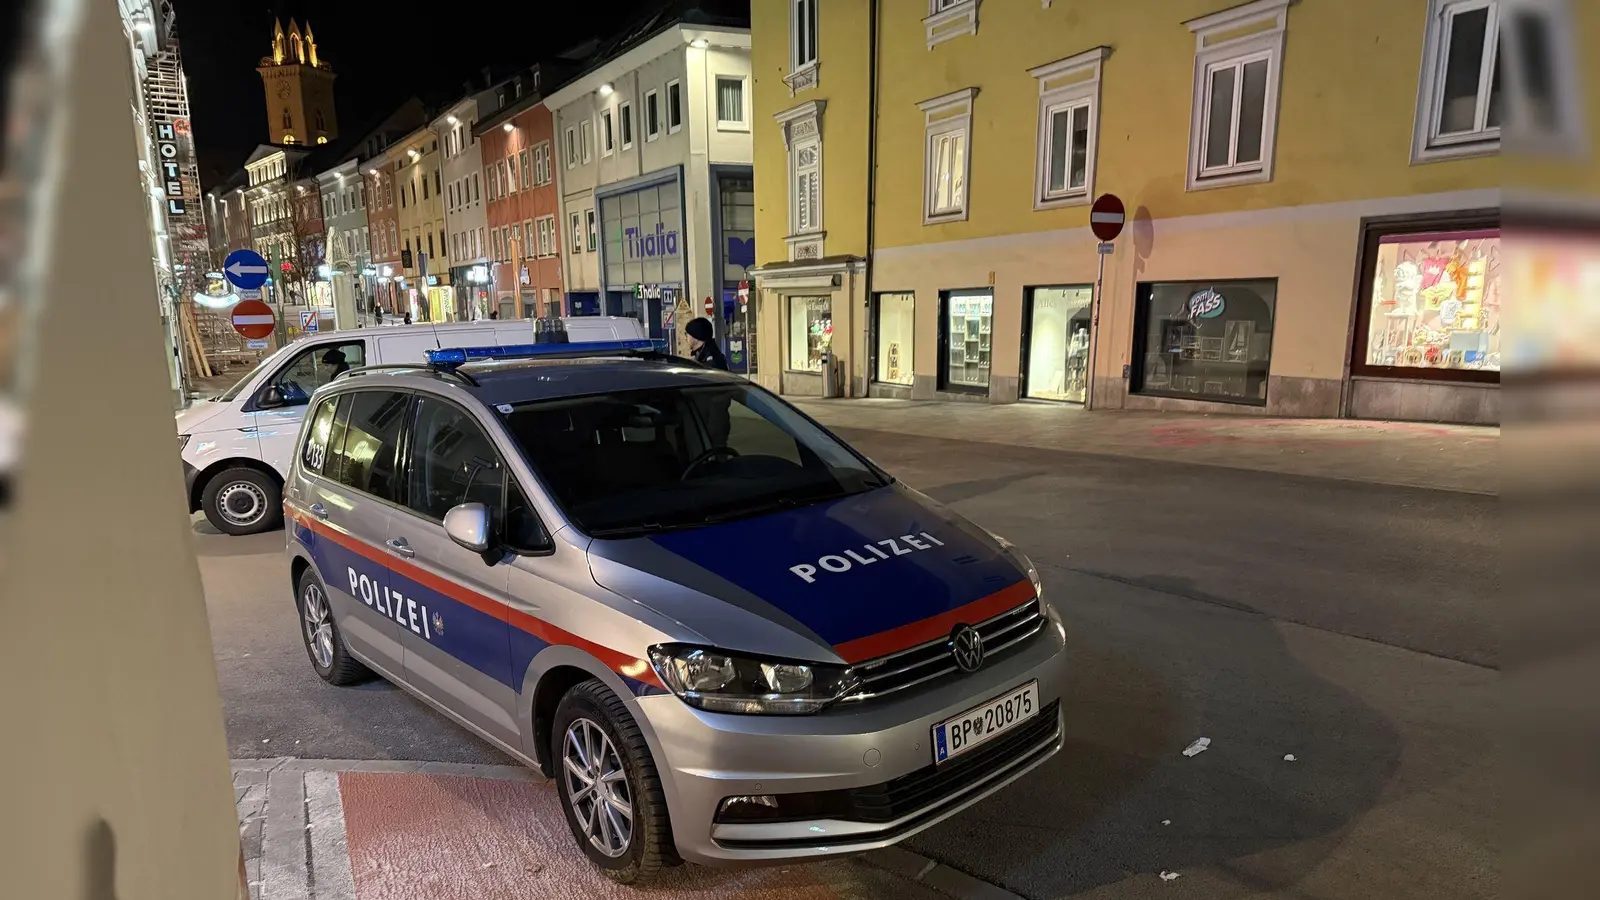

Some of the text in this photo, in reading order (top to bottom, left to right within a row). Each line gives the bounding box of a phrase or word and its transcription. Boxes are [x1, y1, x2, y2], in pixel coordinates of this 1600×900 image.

[158, 124, 184, 214] HOTEL
[625, 222, 677, 258] Thalia
[1190, 294, 1222, 319] FASS
[1191, 292, 1208, 305] vom
[310, 443, 324, 469] 133
[789, 531, 945, 584] POLIZEI
[347, 566, 431, 639] POLIZEI
[951, 690, 1032, 750] BP 20875
[939, 747, 945, 755] A
